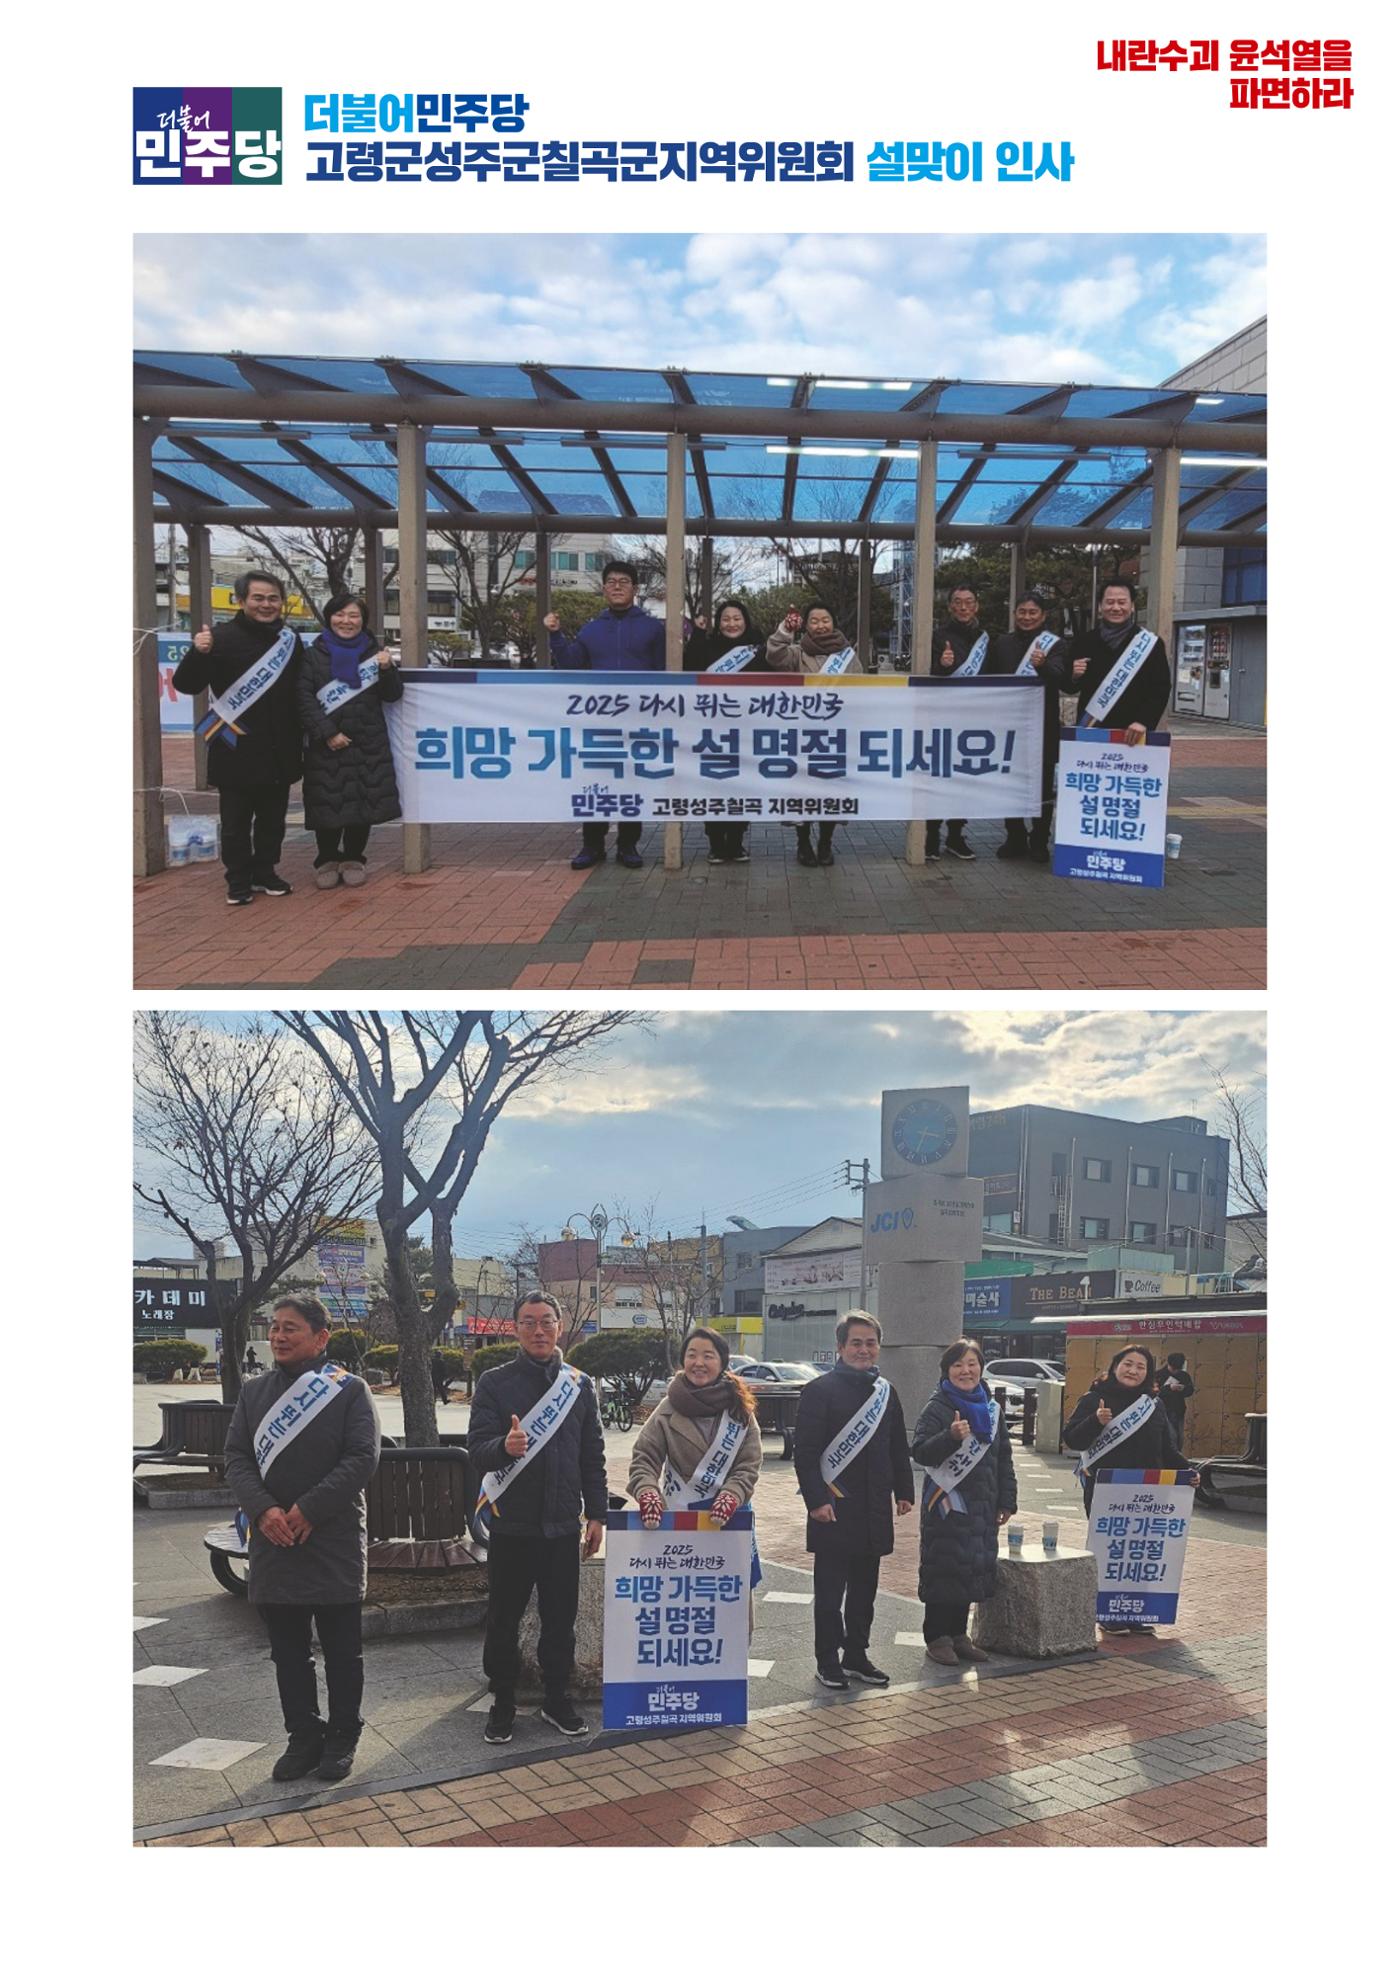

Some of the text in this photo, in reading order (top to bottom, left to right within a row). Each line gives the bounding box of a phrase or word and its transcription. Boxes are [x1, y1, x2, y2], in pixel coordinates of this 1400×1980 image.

[1135, 632, 1151, 652] 다시
[227, 667, 274, 710] 대한민국
[1097, 669, 1129, 709] 대한민국
[566, 691, 845, 721] 2025 다시 뛰는 대한민국
[415, 726, 1017, 780] 희망 가득한 설 명절 되세요!
[1065, 772, 1162, 798] 희망 가득한
[571, 793, 859, 817] 민주당 고령성주칠곡 지역위원회
[1080, 795, 1141, 819] 설 명절
[1080, 817, 1146, 841] 되세요!
[1086, 855, 1126, 871] 민주당
[870, 1210, 899, 1232] JCI
[1030, 1287, 1051, 1301] THE
[1134, 1279, 1161, 1293] Coffee
[293, 1377, 329, 1412] 다시
[552, 1381, 574, 1411] 다시
[268, 1404, 302, 1439] 뛰는
[530, 1405, 559, 1436] 뛰는
[827, 1420, 870, 1469] 대한민국
[694, 1450, 729, 1498] 대한민국
[1095, 1516, 1186, 1538] 희망 가득한
[662, 1544, 694, 1555] 2025
[1107, 1539, 1164, 1560] 설 명절
[629, 1555, 726, 1570] 다시 뛰는 대한민국
[1105, 1562, 1167, 1582] 되세요!
[615, 1575, 743, 1603] 희망 가득한
[1109, 1599, 1144, 1613] 민주당
[635, 1606, 716, 1636] 설 명절
[637, 1638, 723, 1667] 되세요!
[648, 1691, 700, 1712] 민주당
[626, 1712, 722, 1726] 고령성주칠곡 지역위원회
